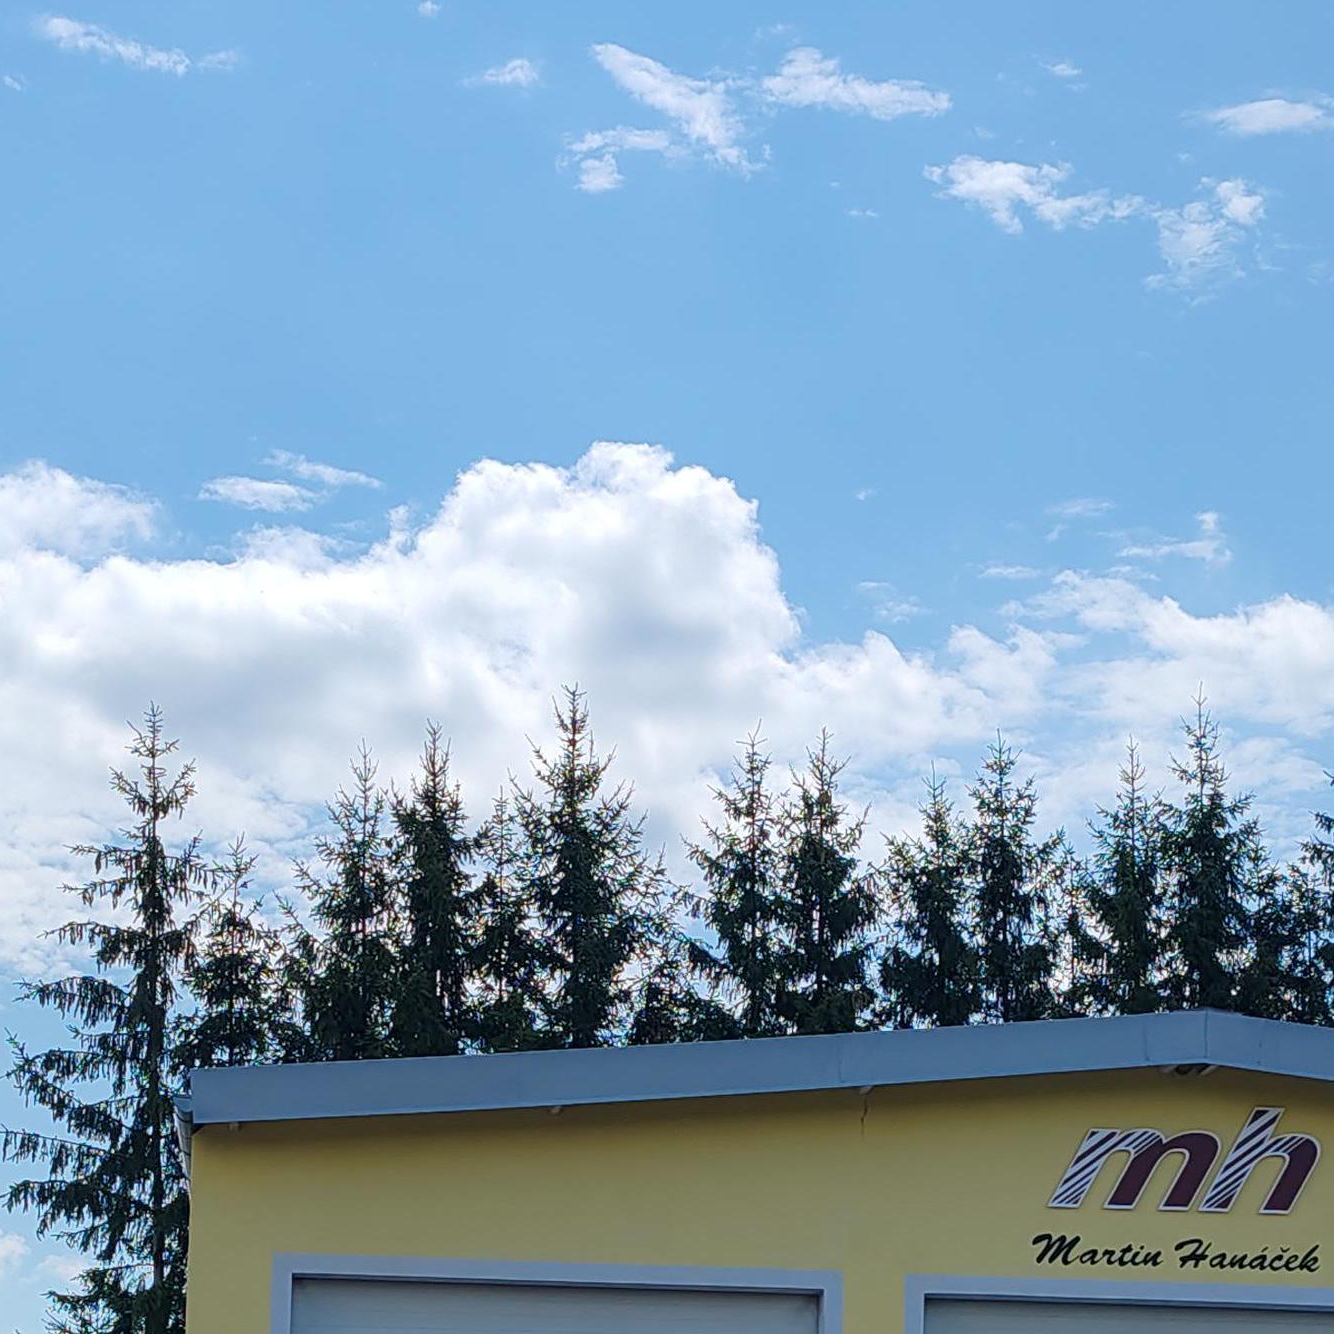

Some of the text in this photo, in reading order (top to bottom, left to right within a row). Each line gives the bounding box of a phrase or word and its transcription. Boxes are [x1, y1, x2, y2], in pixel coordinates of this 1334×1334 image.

[1047, 1106, 1321, 1214] mh
[1032, 1233, 1320, 1273] Martin Hanáček
